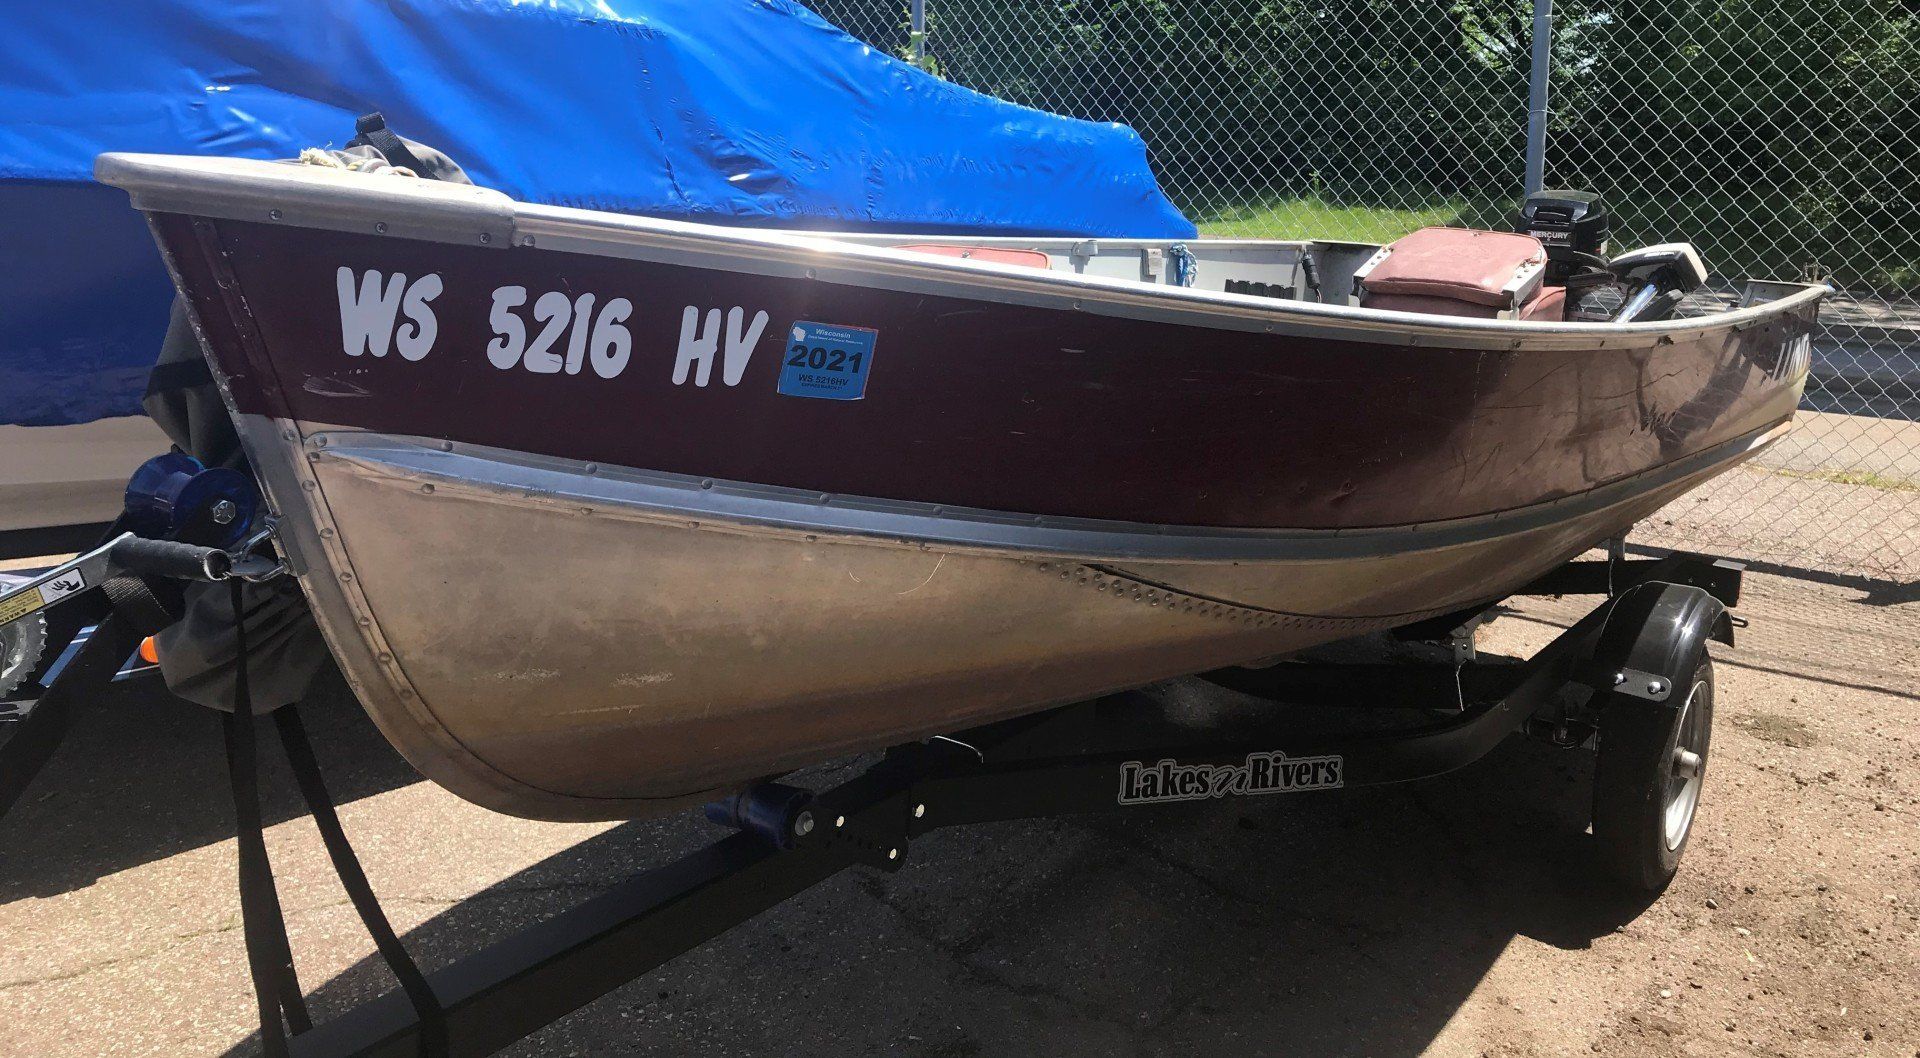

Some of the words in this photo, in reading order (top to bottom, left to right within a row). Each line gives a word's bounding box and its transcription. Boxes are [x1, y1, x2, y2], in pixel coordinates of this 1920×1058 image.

[1530, 230, 1569, 239] MERCURY
[336, 266, 444, 361] WS
[486, 285, 634, 379] 5216
[671, 305, 770, 387] HV
[815, 328, 851, 339] Wisconsin
[787, 344, 863, 374] 2021
[798, 373, 813, 383] WS
[815, 375, 849, 386] 5216HV
[1123, 763, 1211, 800] Lakes
[1249, 755, 1340, 790] Rivers
